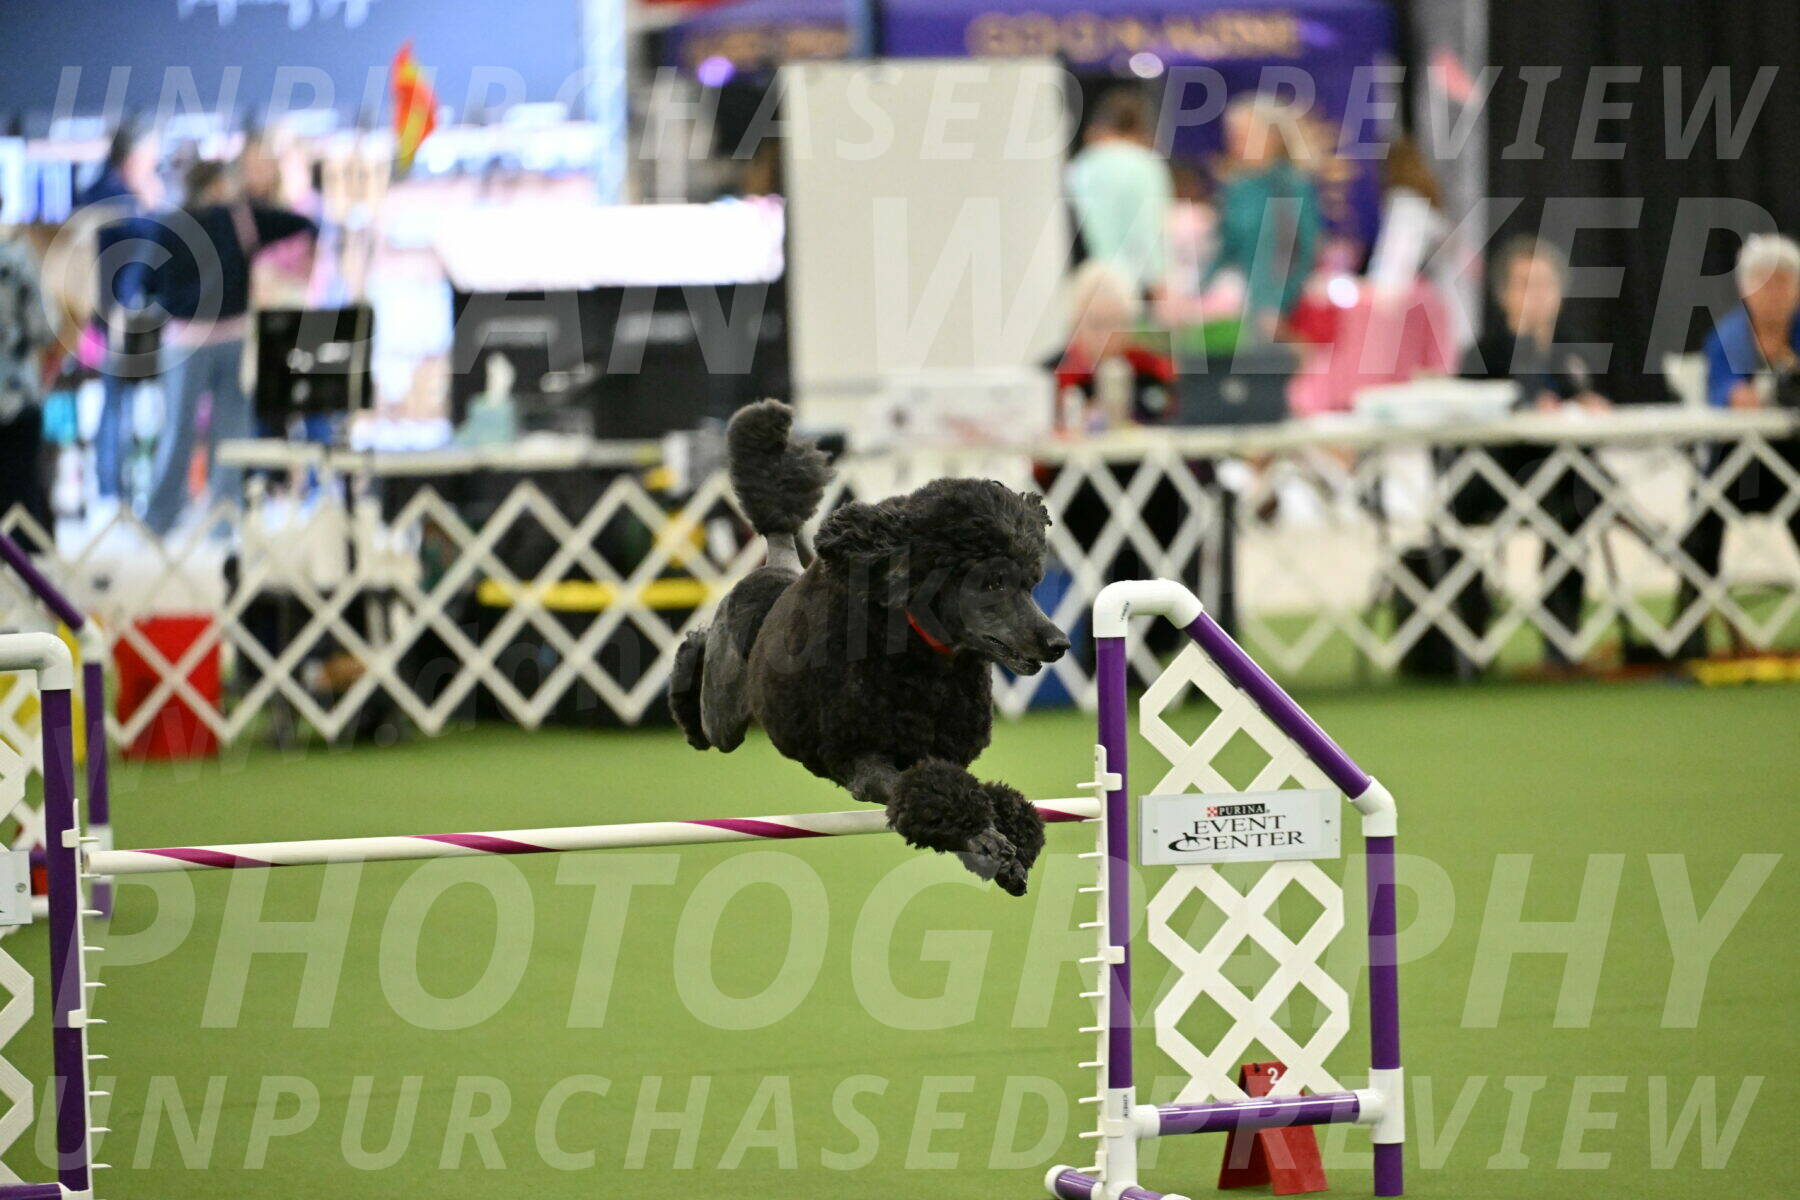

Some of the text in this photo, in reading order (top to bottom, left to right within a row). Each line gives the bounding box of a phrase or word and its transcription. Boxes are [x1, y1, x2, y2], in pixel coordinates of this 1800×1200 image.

[1219, 804, 1264, 816] PURINA
[1193, 815, 1286, 834] EVENT
[1168, 830, 1305, 852] CENTER
[1267, 1066, 1280, 1085] 2
